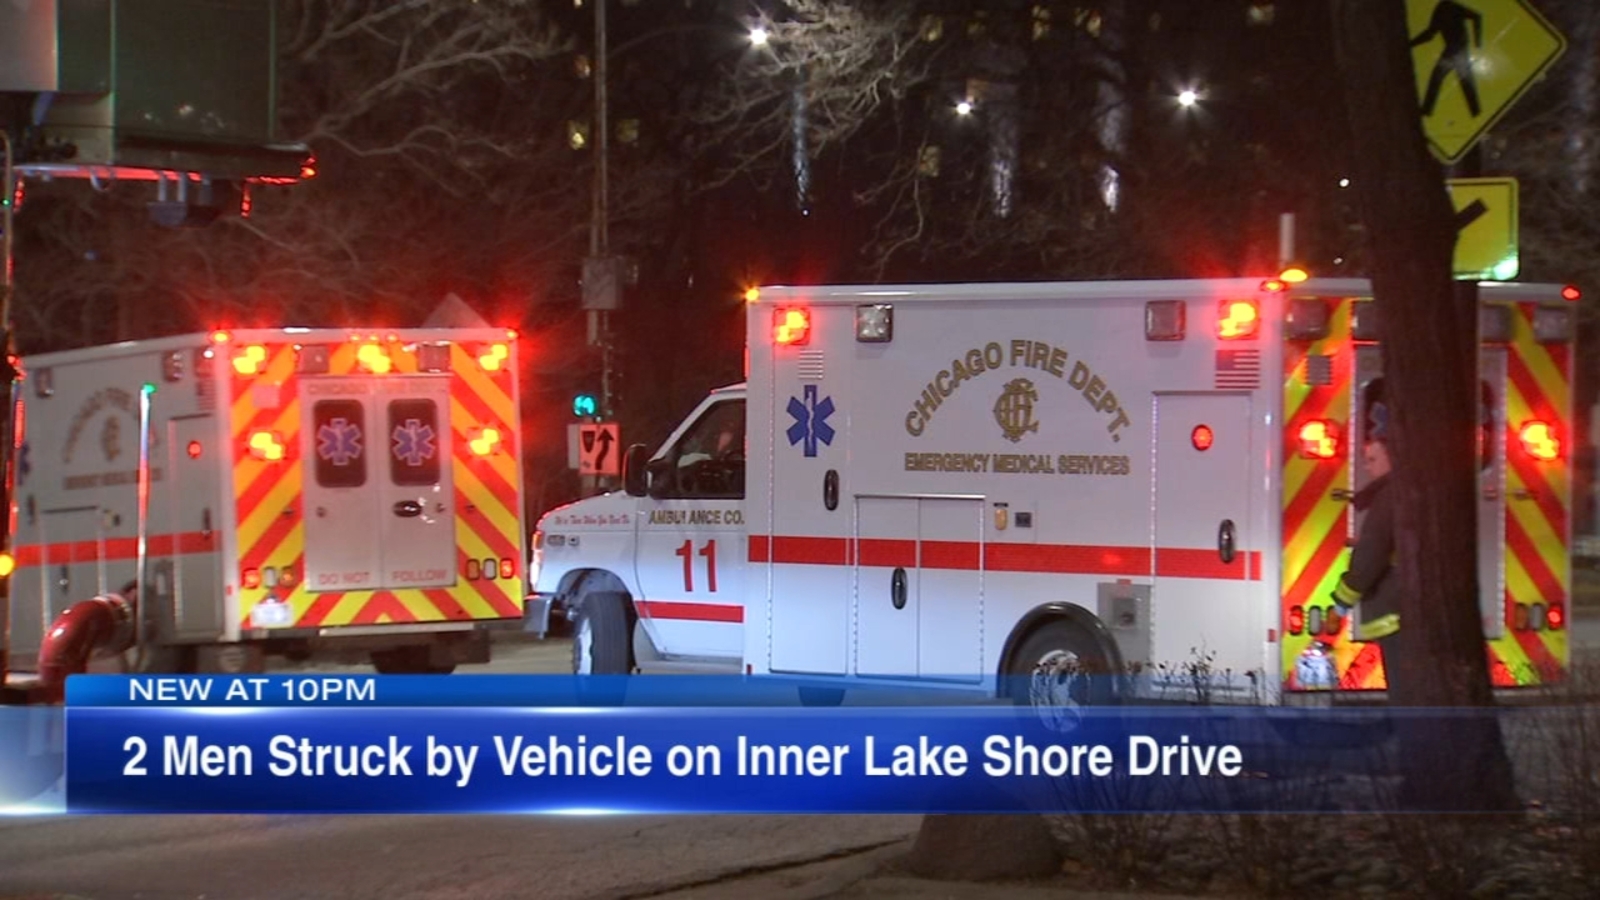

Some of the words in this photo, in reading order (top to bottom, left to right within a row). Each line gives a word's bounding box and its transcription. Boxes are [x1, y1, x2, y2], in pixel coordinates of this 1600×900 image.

[905, 342, 1003, 437] CHICAGO
[1010, 339, 1068, 378] FIRE
[1068, 360, 1131, 443] DEPT.
[904, 452, 991, 473] EMERGENCY
[993, 453, 1055, 475] MEDICAL
[1058, 455, 1130, 476] SERVICES
[723, 509, 746, 526] CO.
[318, 573, 339, 585] DO
[343, 571, 371, 585] NOT
[391, 569, 448, 582] FOLLOW
[675, 539, 718, 592] 11
